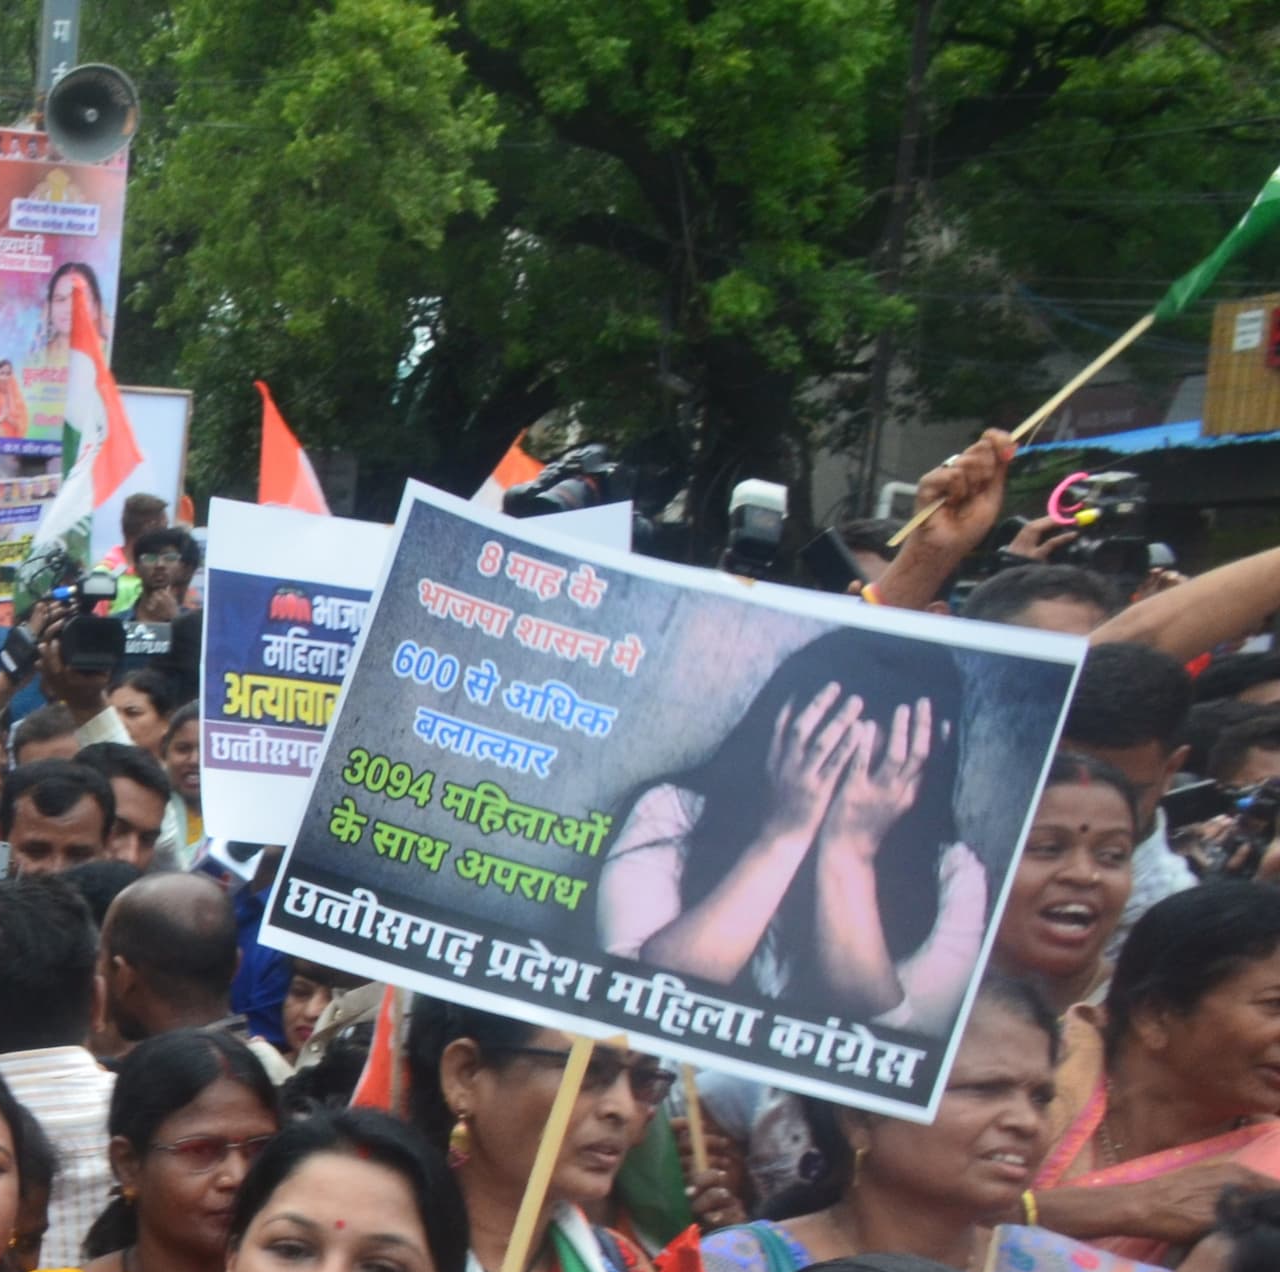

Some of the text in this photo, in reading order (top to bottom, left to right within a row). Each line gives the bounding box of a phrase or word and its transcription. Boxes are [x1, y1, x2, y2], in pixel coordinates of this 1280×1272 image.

[417, 578, 513, 639] भाजपा
[513, 615, 611, 668] शासन
[478, 541, 608, 609] 8 माह के
[392, 640, 619, 738] 600 से अधिक
[413, 706, 557, 780] बलात्कार
[342, 747, 613, 857] 3094 महिलाओं
[328, 797, 589, 911] के साथ अपराध
[282, 876, 928, 1088] छत्तीसगढ़ प्रदेश महिला कांग्रेस
